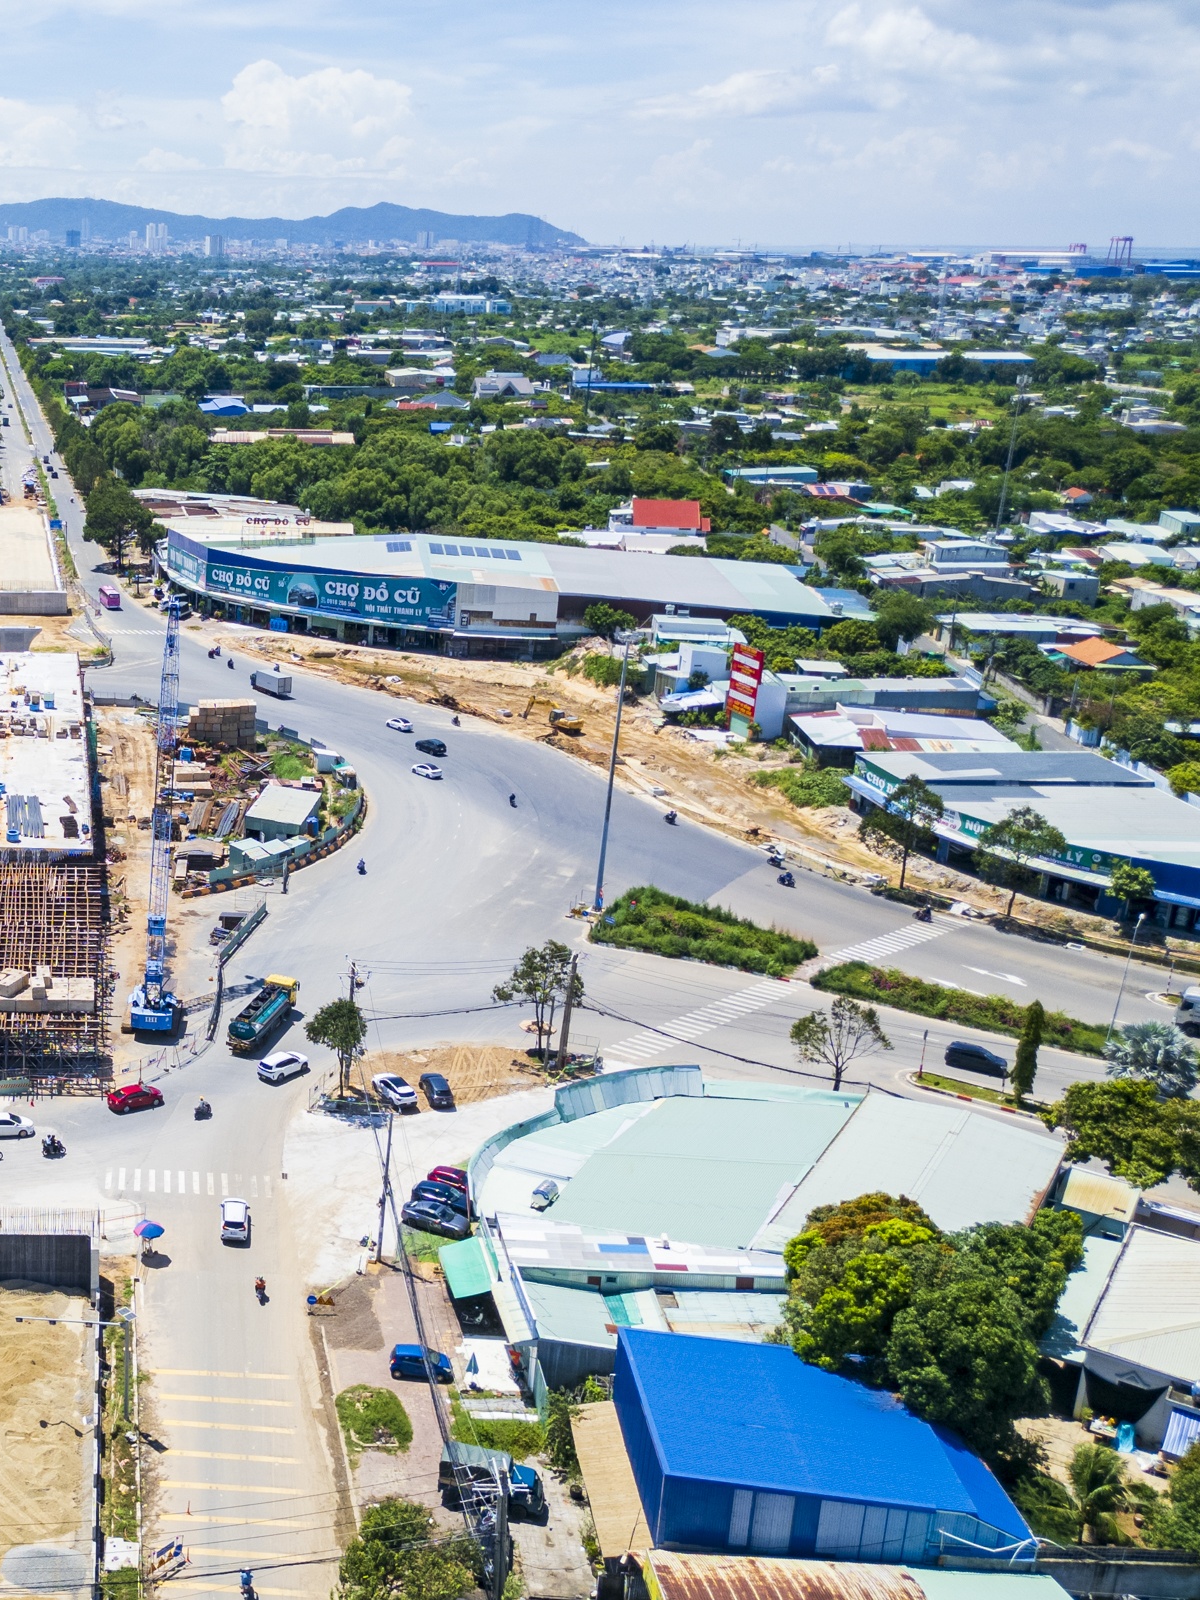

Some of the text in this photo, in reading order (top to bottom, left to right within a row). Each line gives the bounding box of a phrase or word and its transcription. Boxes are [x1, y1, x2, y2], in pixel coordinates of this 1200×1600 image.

[212, 569, 233, 587] CHỢ
[236, 570, 252, 587] ĐỒ
[254, 576, 270, 591] CŨ
[325, 581, 420, 604] CHỢ ĐỒ CŨ
[365, 604, 375, 615] NỘI
[377, 604, 392, 614] THẤT
[394, 607, 414, 616] THANH
[415, 607, 422, 616] LÝ
[866, 771, 885, 792] CHỢ
[965, 820, 985, 835] NỘI
[1066, 851, 1083, 863] LÝ
